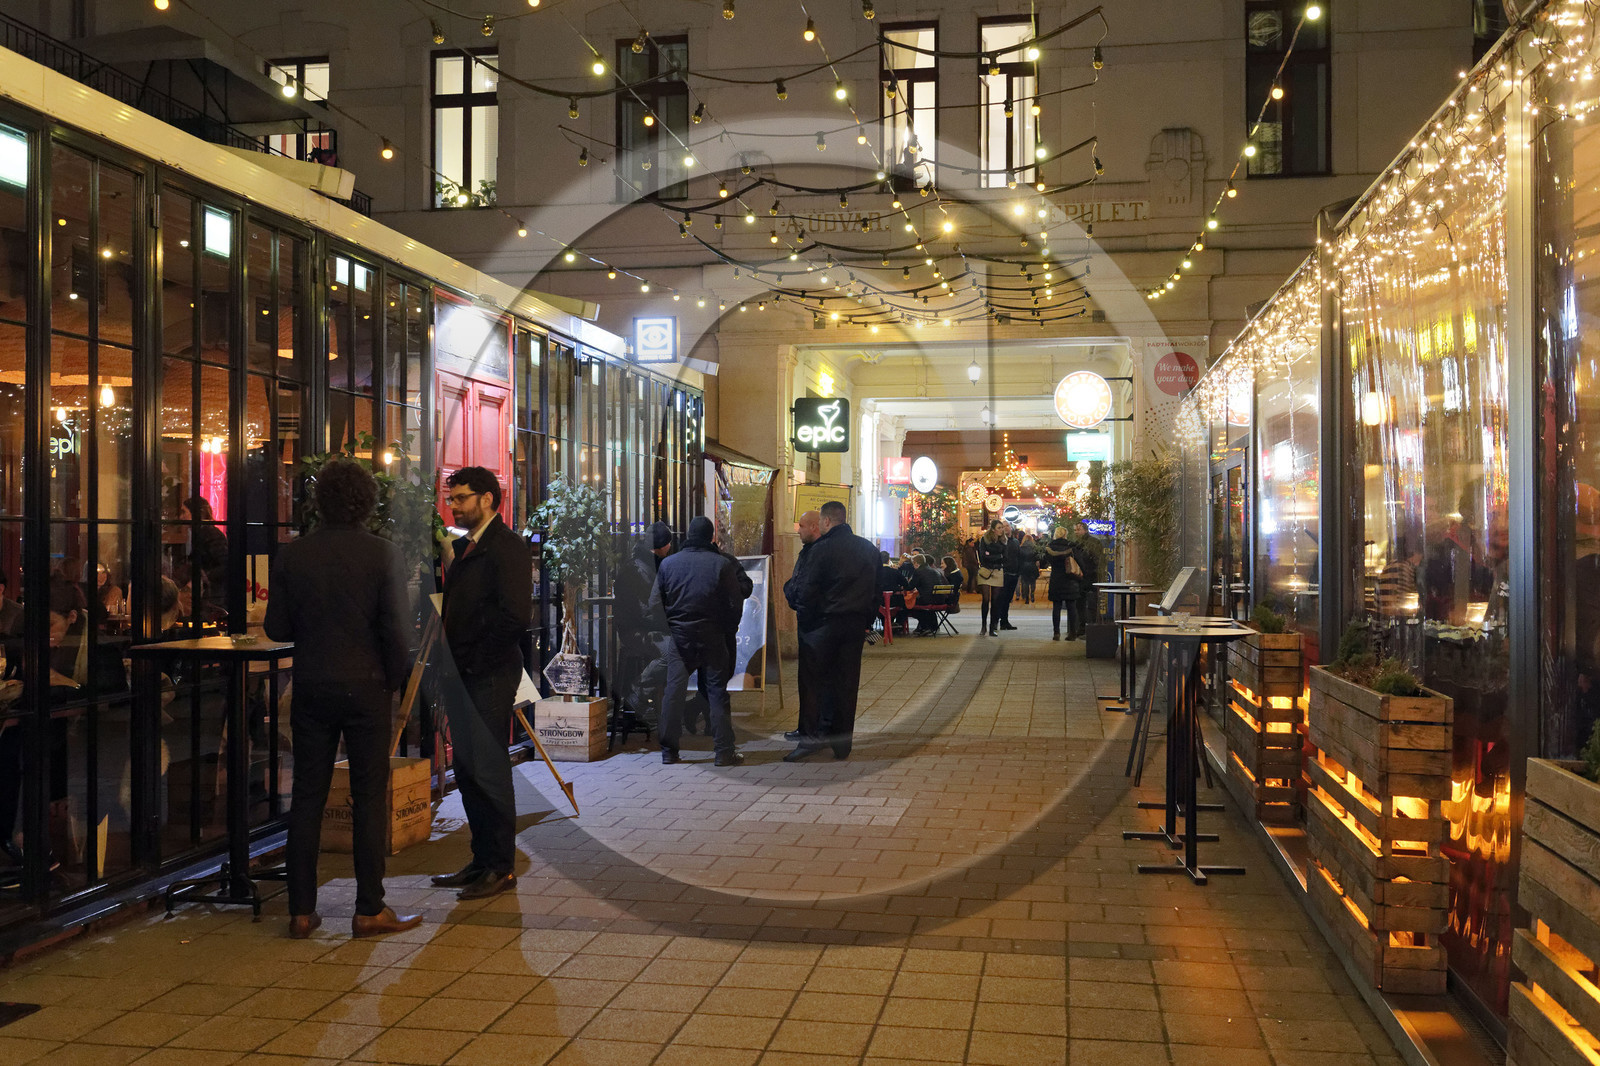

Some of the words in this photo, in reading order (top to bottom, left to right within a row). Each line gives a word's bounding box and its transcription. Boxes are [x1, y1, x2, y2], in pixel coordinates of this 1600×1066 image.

[1157, 362, 1171, 372] We
[1172, 363, 1195, 372] make
[1156, 375, 1176, 385] your
[1177, 374, 1196, 385] day.
[1059, 402, 1108, 425] WOK2GO
[796, 420, 846, 449] epic
[539, 729, 585, 738] STRONGBOW
[395, 802, 428, 821] STRONGBOW
